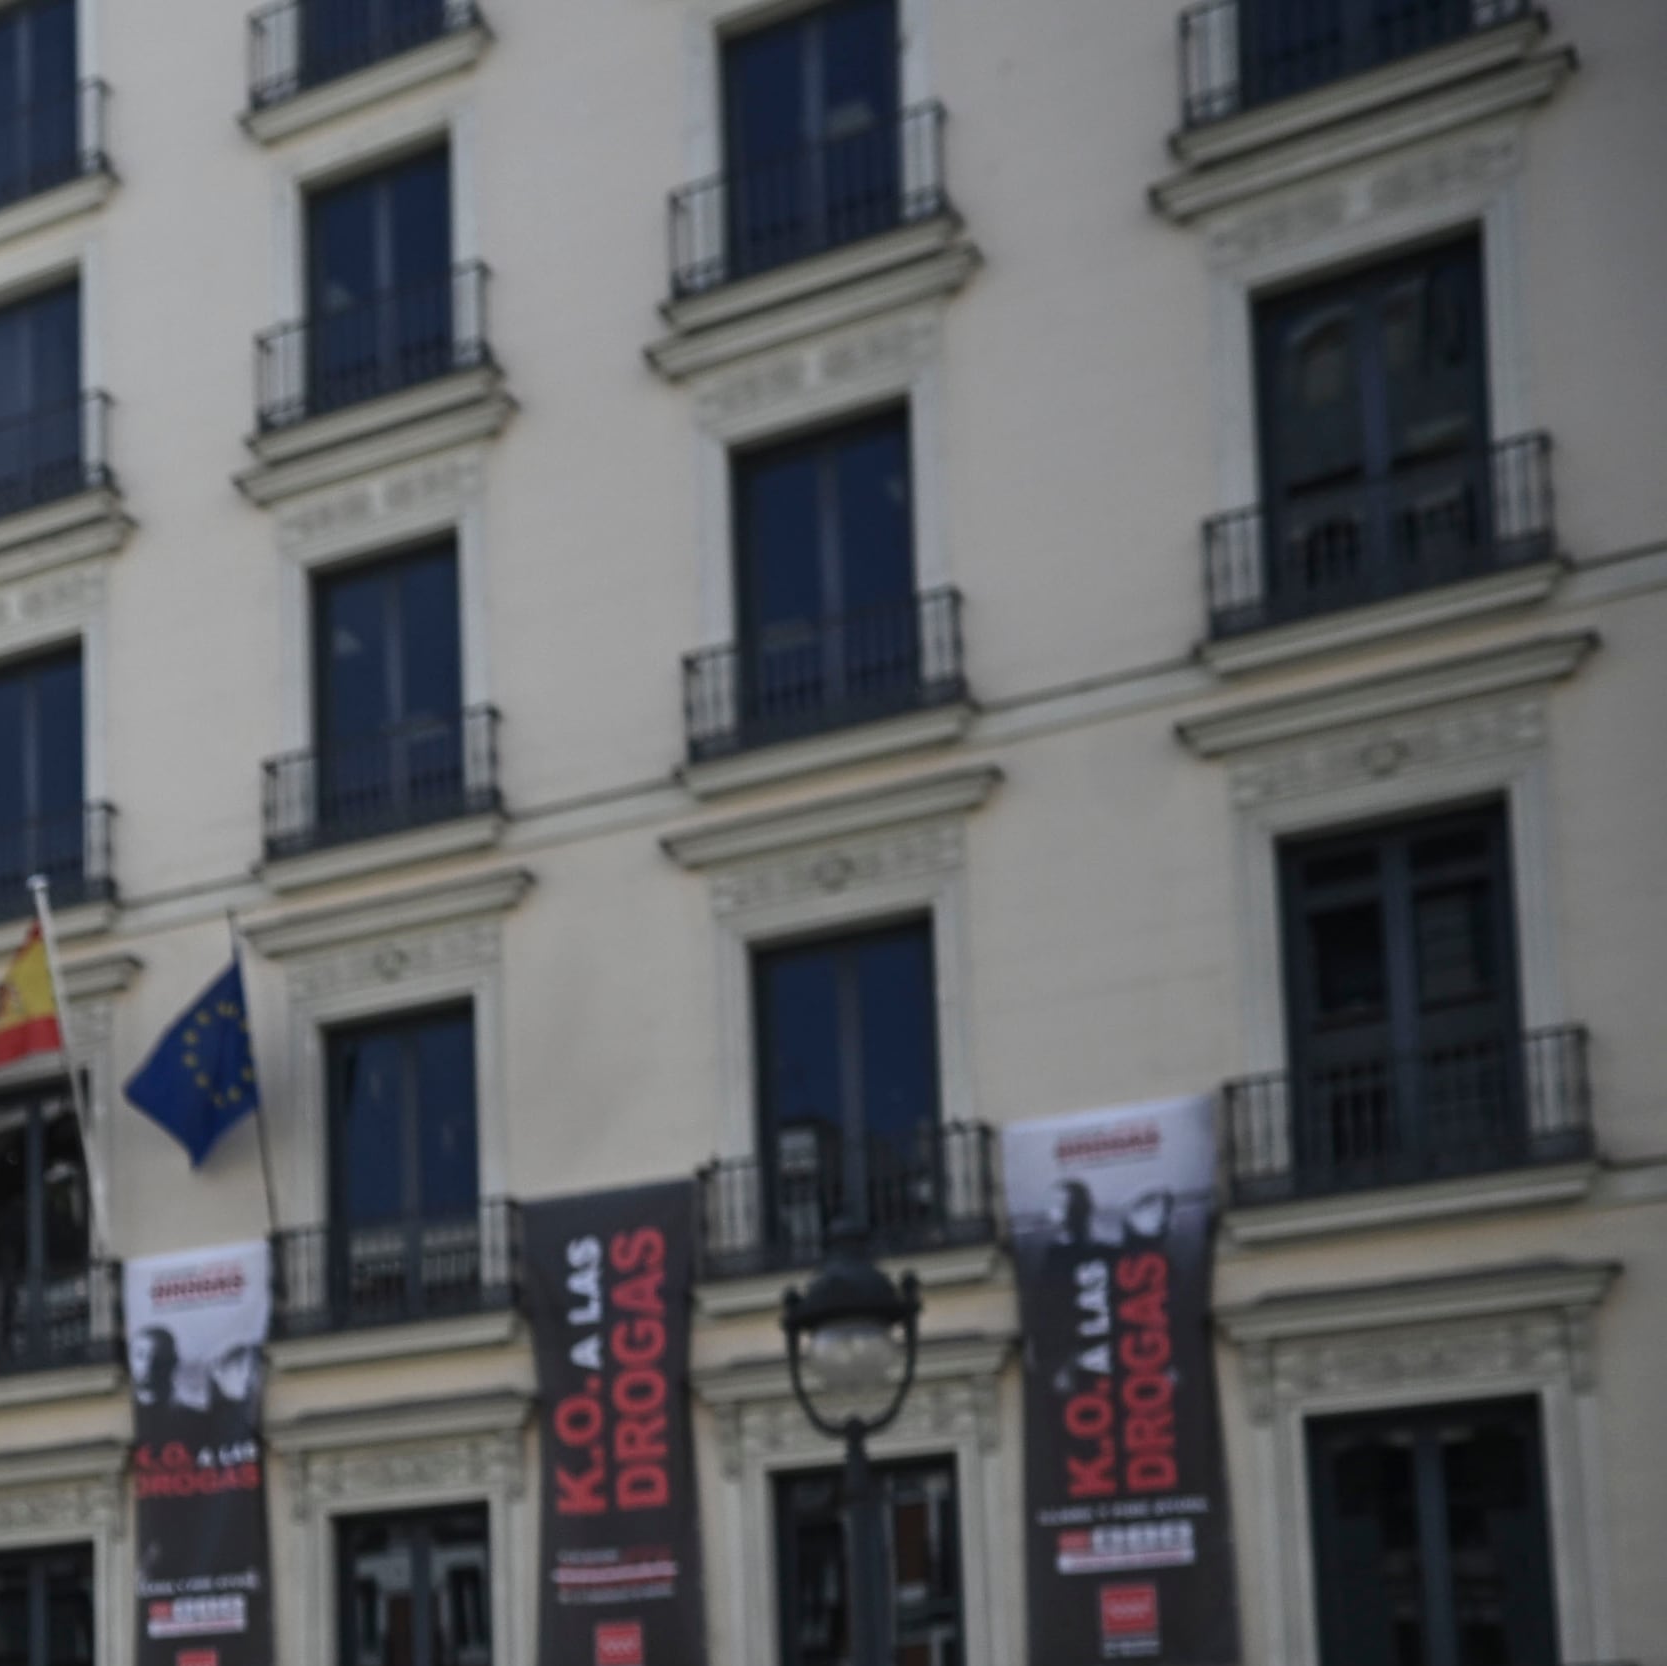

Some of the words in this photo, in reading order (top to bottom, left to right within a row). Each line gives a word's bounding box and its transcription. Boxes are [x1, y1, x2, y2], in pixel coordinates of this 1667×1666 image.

[566, 1234, 603, 1325] LAS
[569, 1332, 604, 1371] A
[610, 1225, 670, 1512] DROGAS
[1077, 1342, 1112, 1375] A
[1116, 1252, 1178, 1493] DROGAS
[553, 1373, 607, 1516] K.O.
[1064, 1376, 1117, 1498] K.O.
